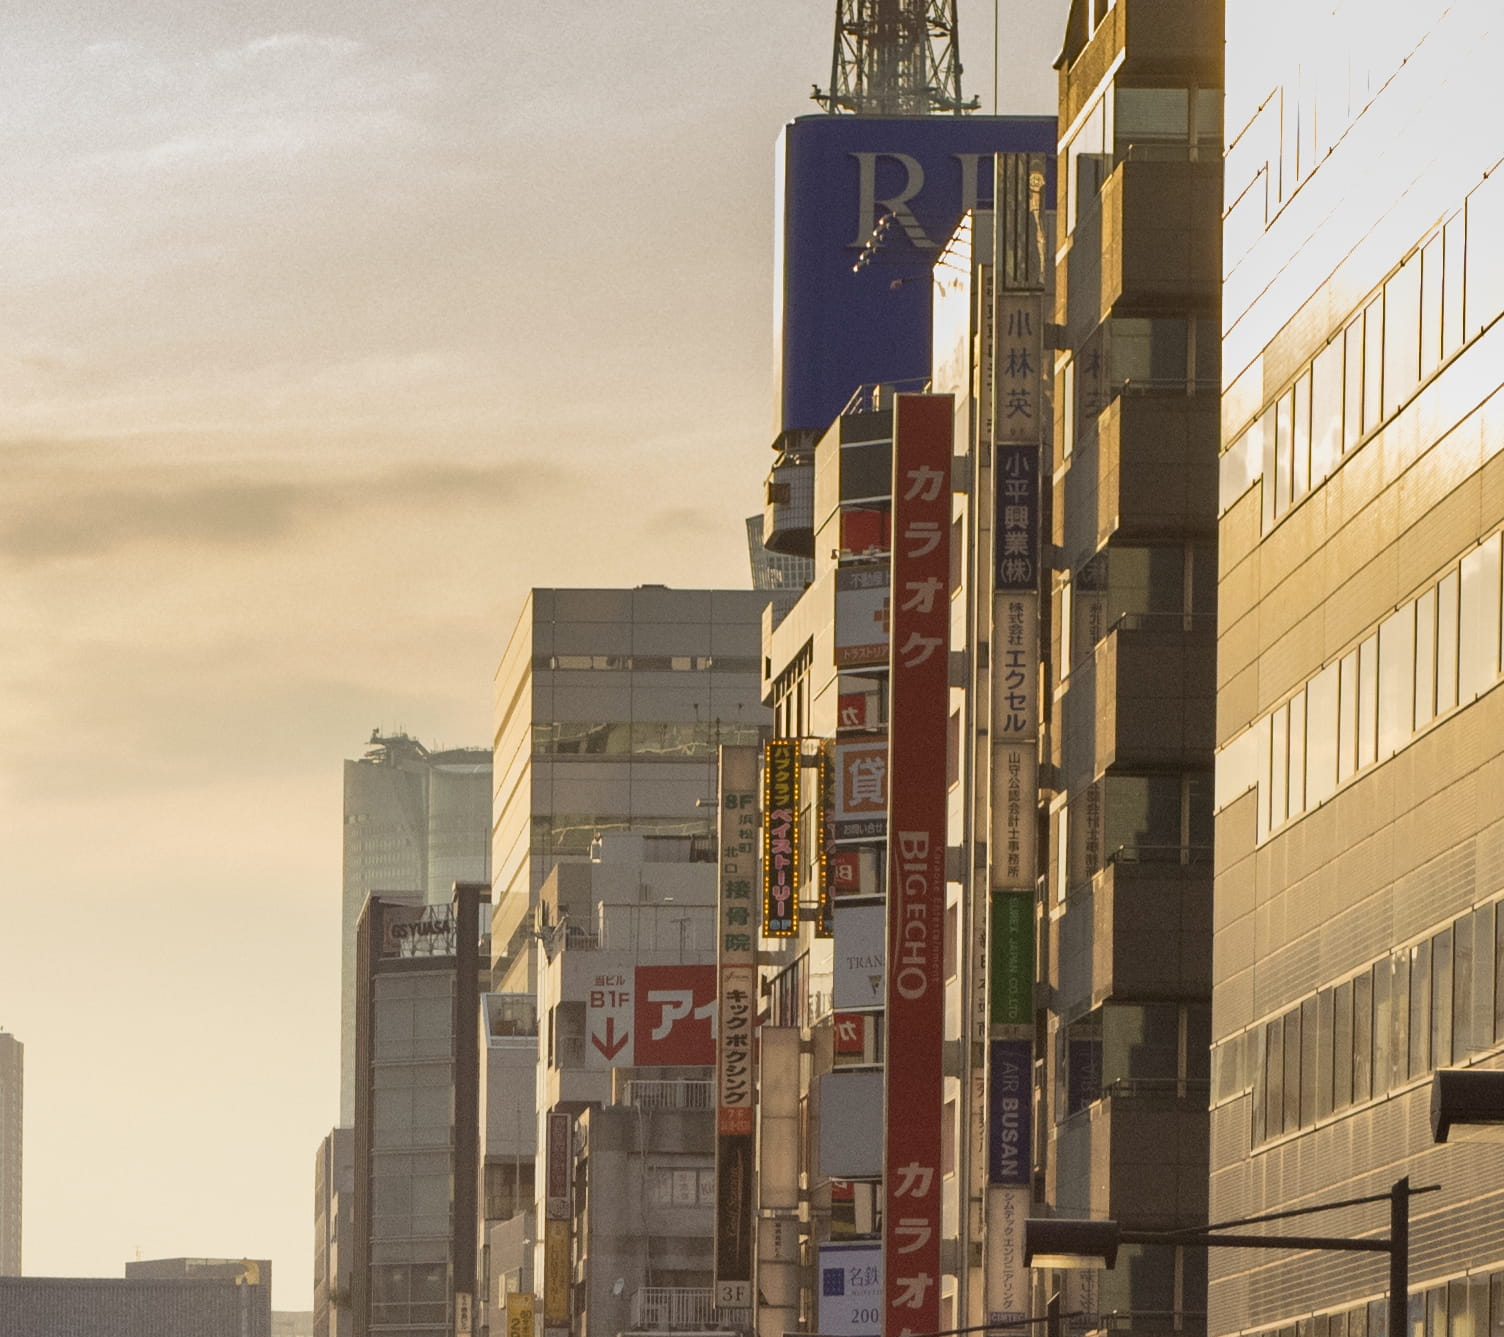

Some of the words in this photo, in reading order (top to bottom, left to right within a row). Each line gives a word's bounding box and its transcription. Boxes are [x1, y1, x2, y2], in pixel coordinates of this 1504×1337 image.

[1005, 308, 1033, 418] 小林英
[902, 465, 945, 668] カラオケ
[1004, 650, 1027, 732] エクセル
[725, 846, 738, 874] 北口
[590, 991, 630, 1009] B1F
[726, 989, 749, 1105] キックボクシング
[1002, 1061, 1017, 1101] AIR
[1000, 1107, 1020, 1178] BUSAN
[723, 1287, 745, 1301] 3F
[850, 1265, 879, 1287] 名鉄
